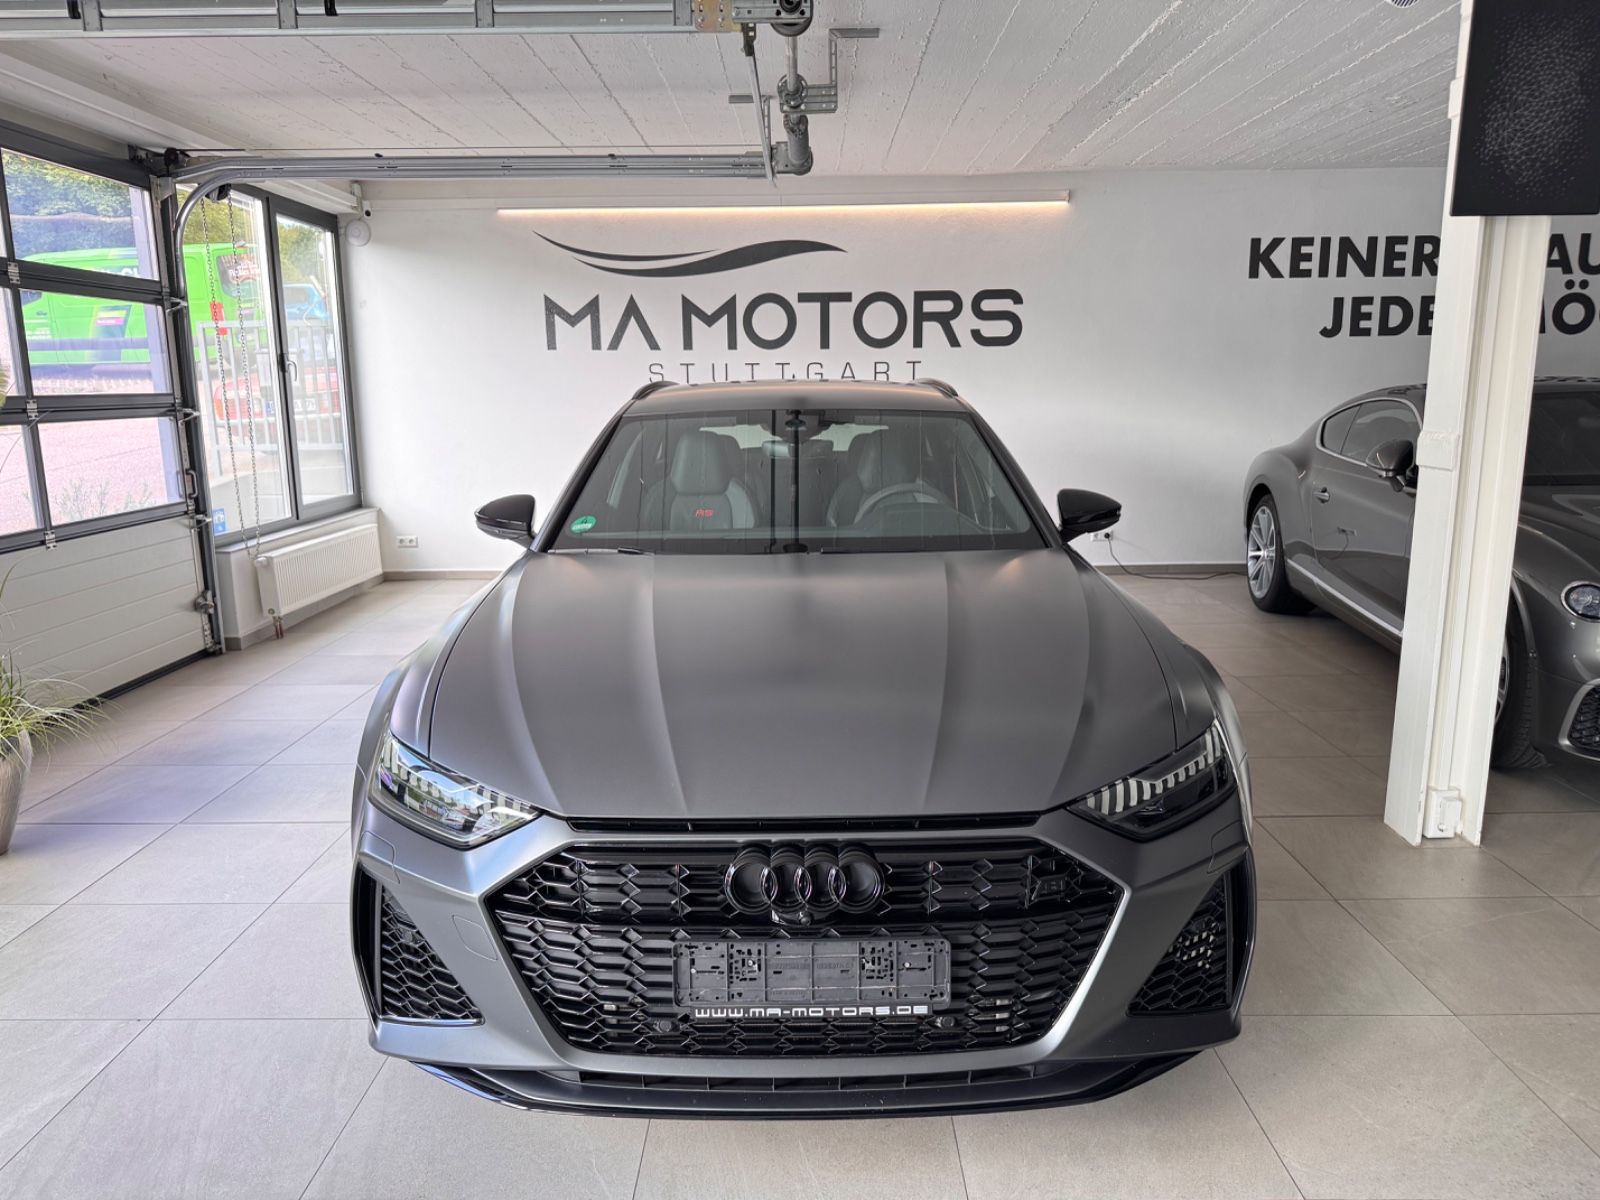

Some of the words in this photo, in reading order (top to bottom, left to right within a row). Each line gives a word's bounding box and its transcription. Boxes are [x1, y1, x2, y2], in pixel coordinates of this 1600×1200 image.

[1248, 235, 1441, 279] KEINER
[543, 293, 662, 351] MA
[681, 288, 1024, 351] MOTORS
[648, 360, 922, 382] STUTTGART
